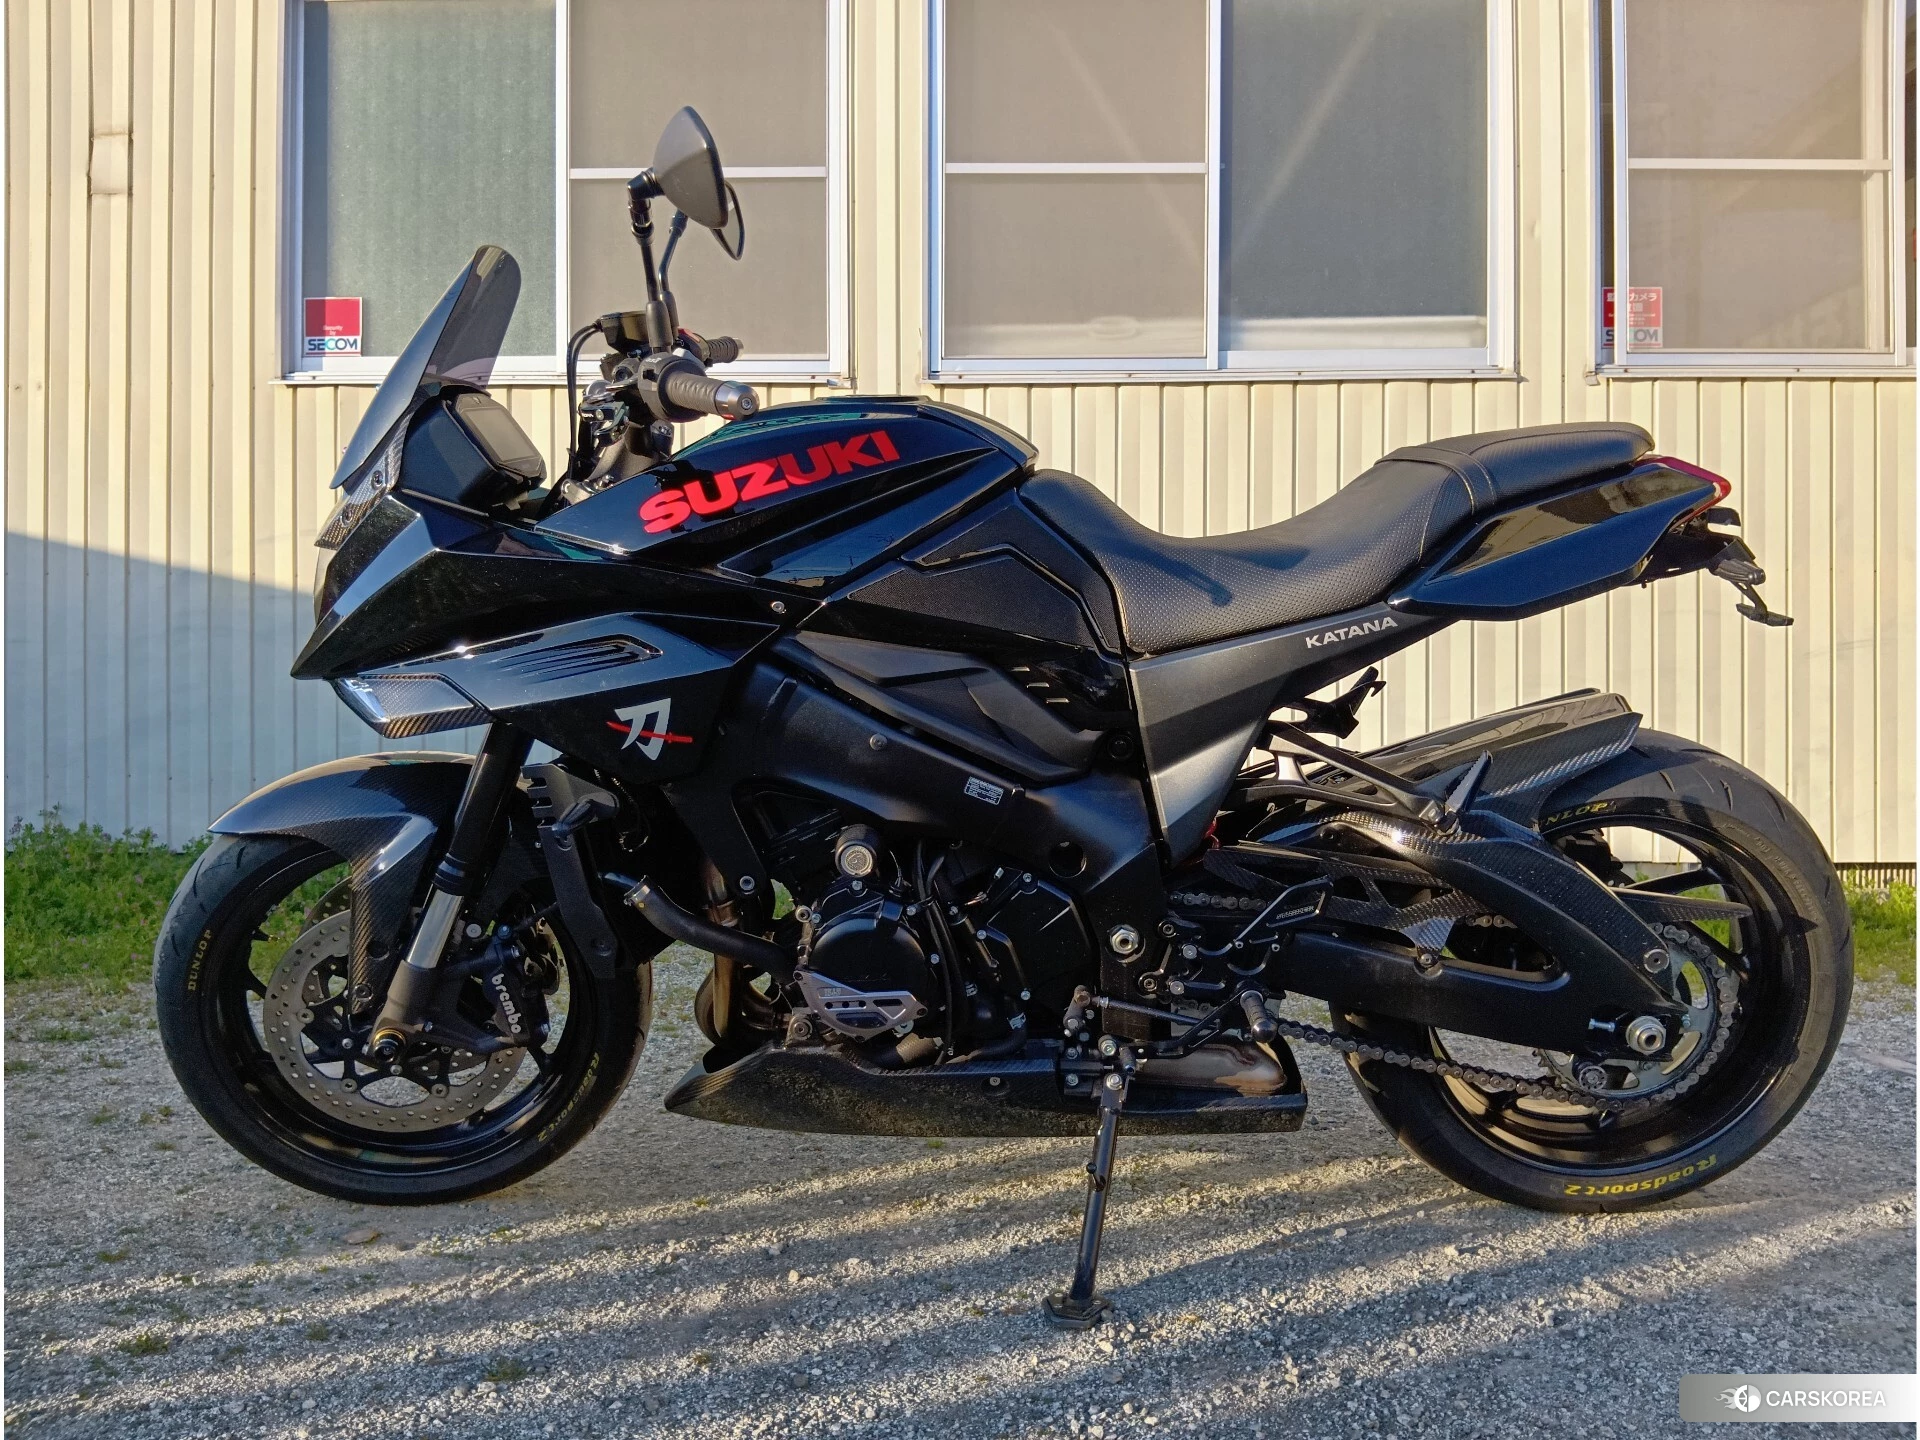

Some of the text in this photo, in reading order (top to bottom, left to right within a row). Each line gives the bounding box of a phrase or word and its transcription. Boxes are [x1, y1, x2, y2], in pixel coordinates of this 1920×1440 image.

[1606, 292, 1658, 302] カメラ
[308, 338, 358, 351] SECOM
[1605, 329, 1659, 342] SOM
[639, 430, 900, 534] SUZUKI
[1305, 616, 1398, 649] KATANA
[1545, 801, 1608, 826] NLOP
[187, 929, 212, 991] DUNLOP
[491, 973, 522, 1034] brembo
[1564, 1154, 1717, 1196] Roadsport 2
